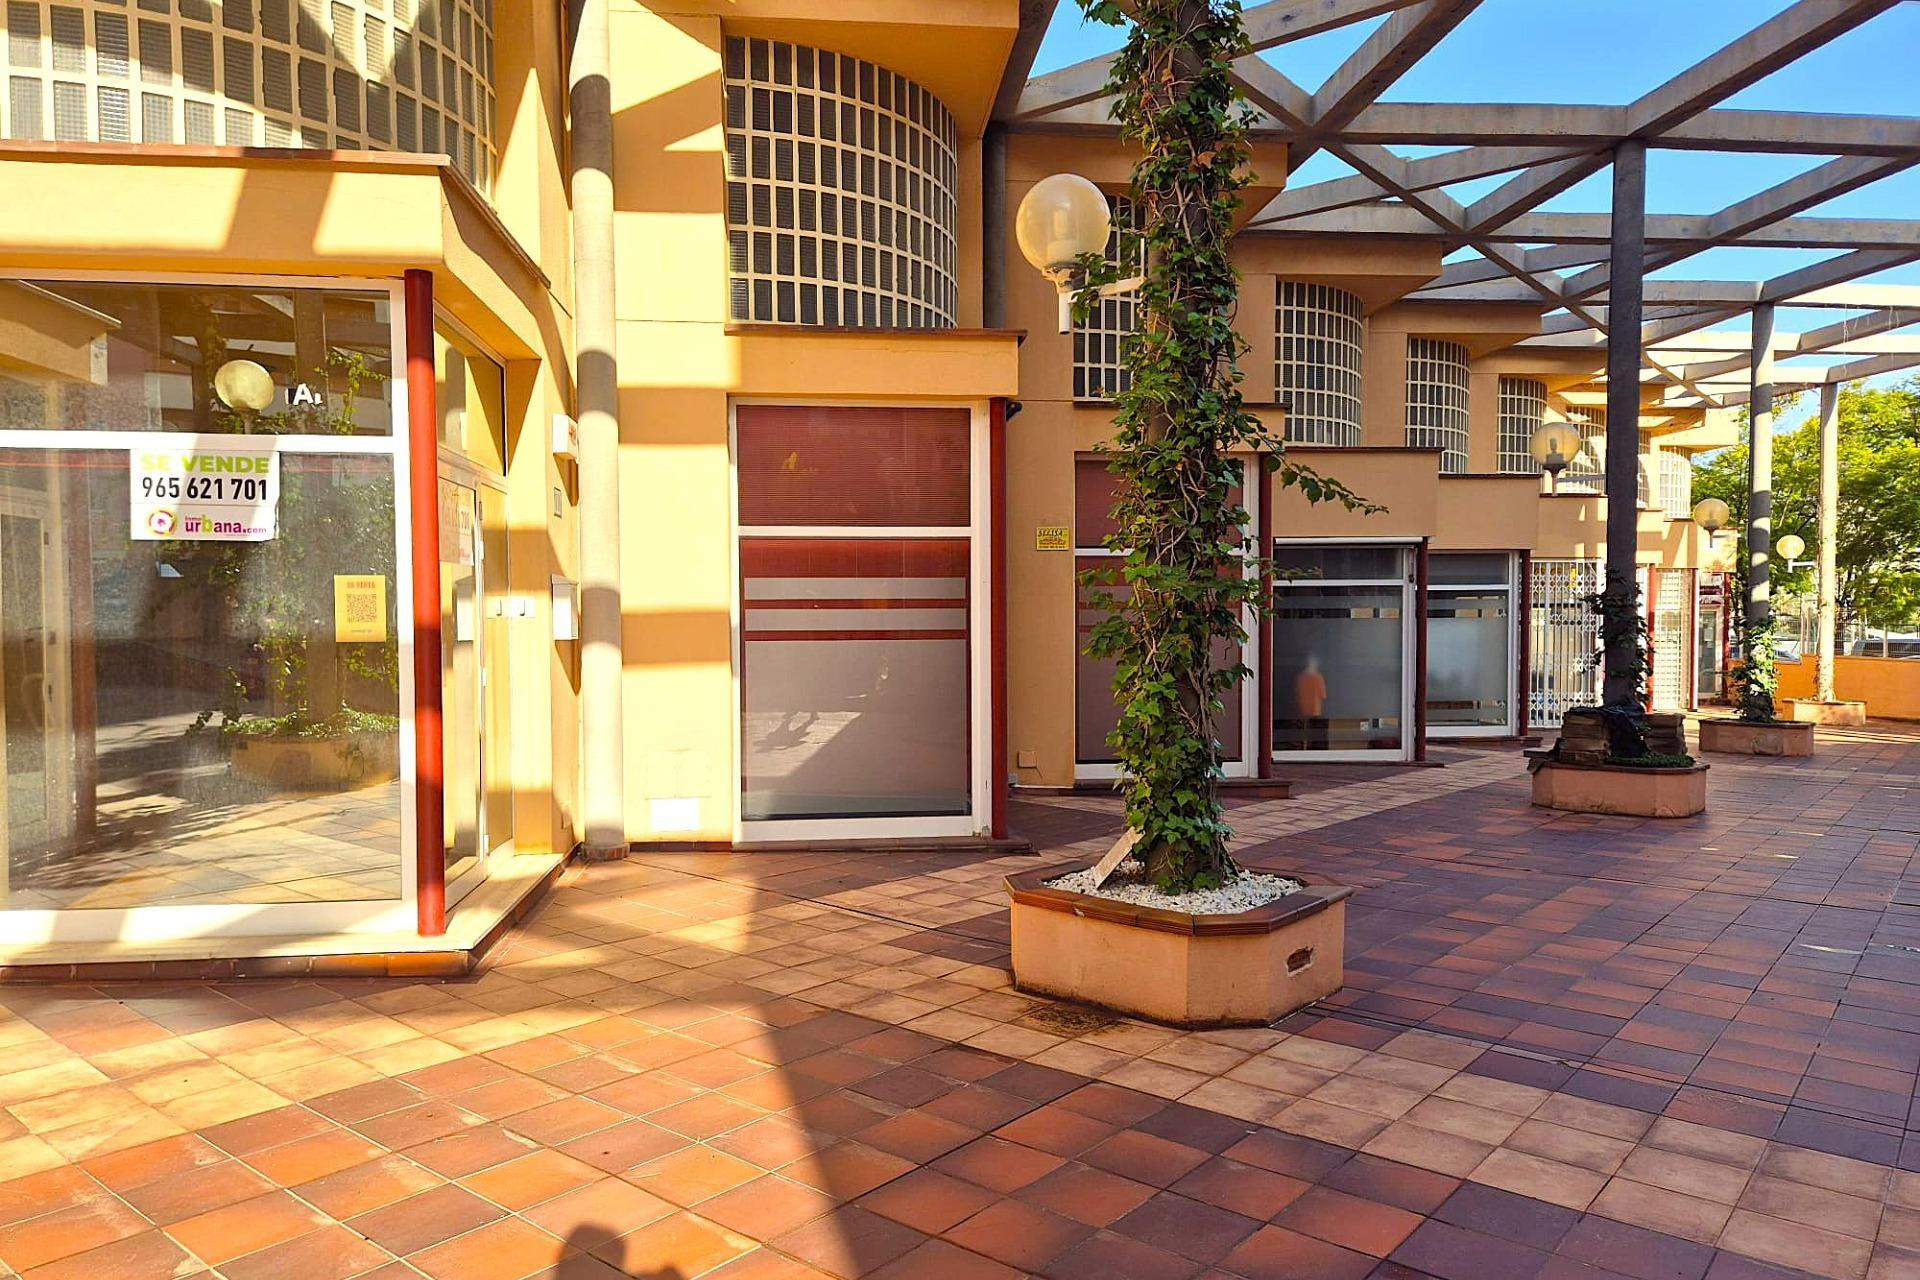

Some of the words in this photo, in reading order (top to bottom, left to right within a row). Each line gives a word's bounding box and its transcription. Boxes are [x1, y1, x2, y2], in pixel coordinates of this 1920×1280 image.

[140, 454, 170, 471] SE
[181, 455, 269, 473] VENDE
[142, 477, 180, 498] 965
[187, 478, 223, 499] 621
[231, 478, 267, 500] 701
